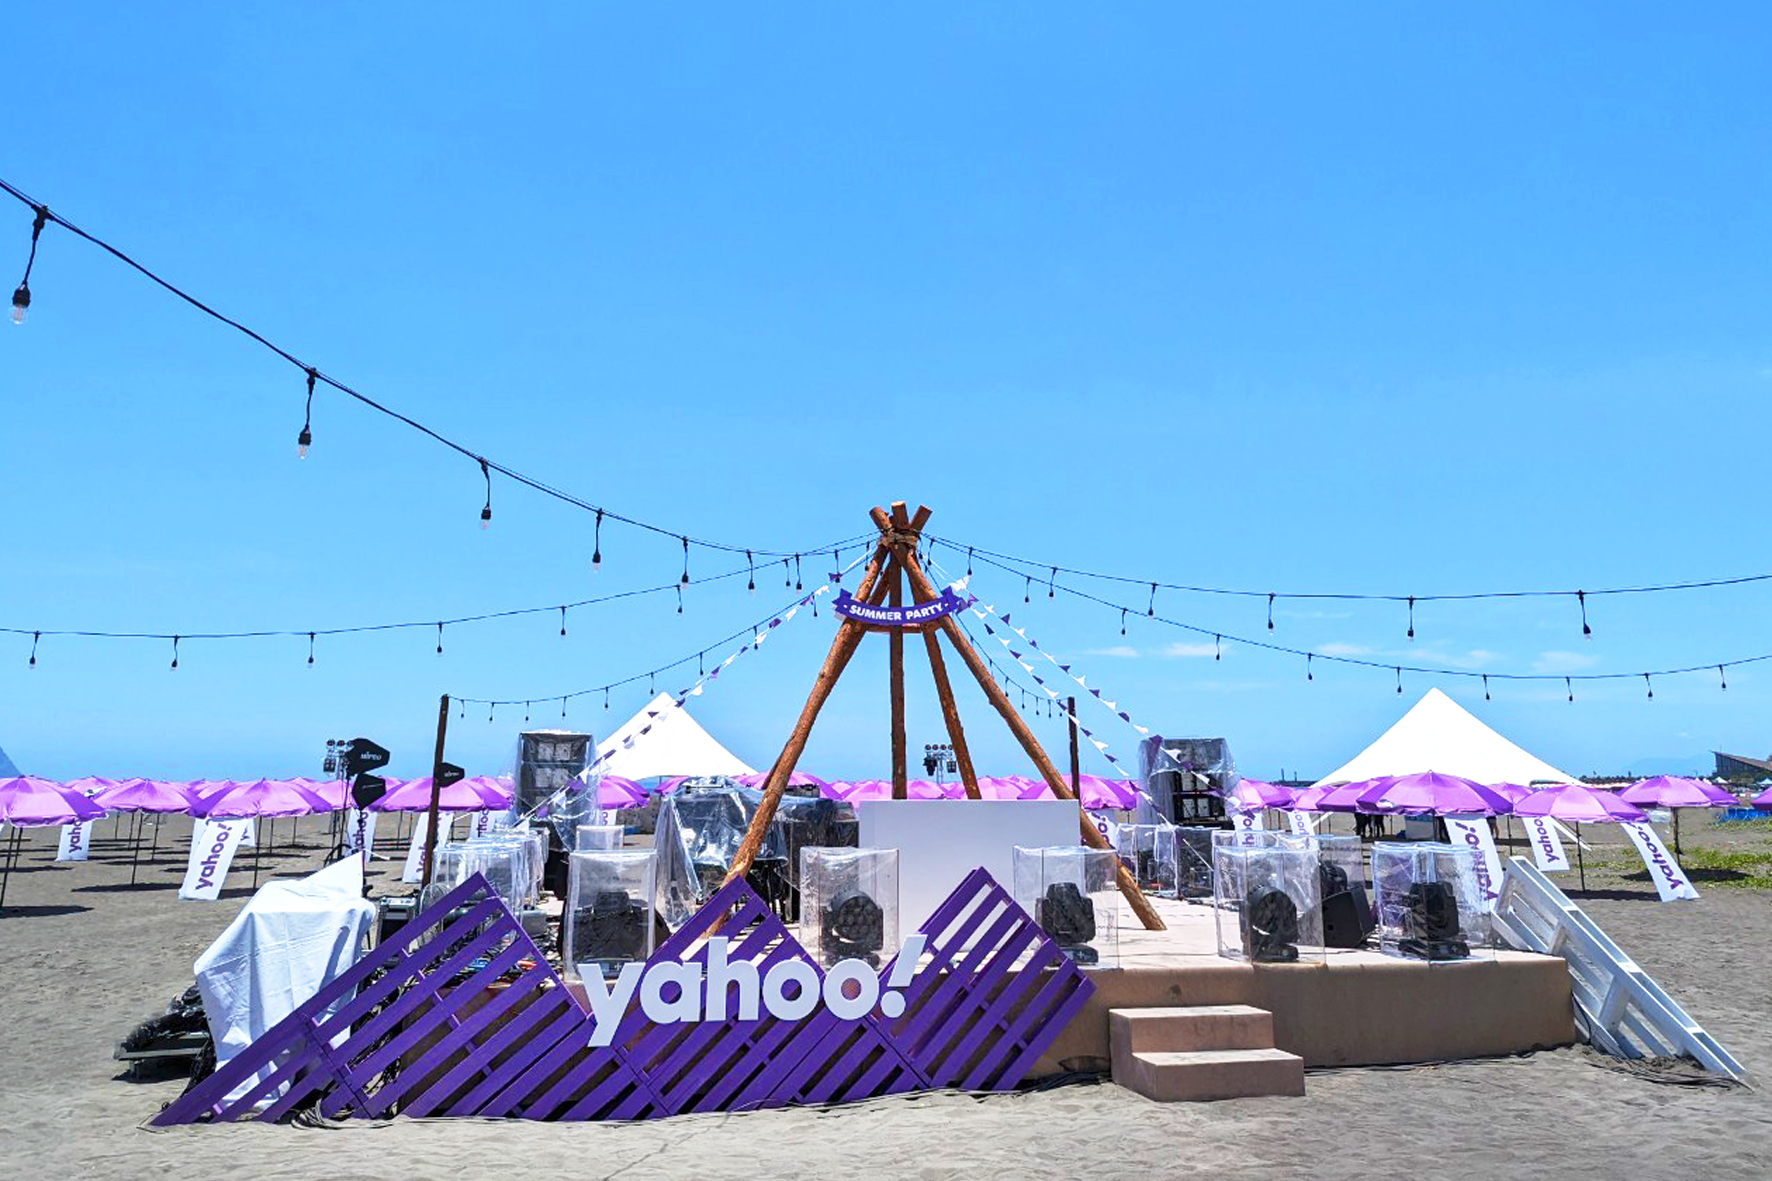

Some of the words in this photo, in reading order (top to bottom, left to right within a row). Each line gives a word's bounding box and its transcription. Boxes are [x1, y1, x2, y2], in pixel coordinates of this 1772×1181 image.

[849, 604, 902, 621] SUMMER
[905, 602, 943, 620] PARTY
[195, 823, 232, 890] yahoo!
[577, 933, 928, 1048] yahoo!
